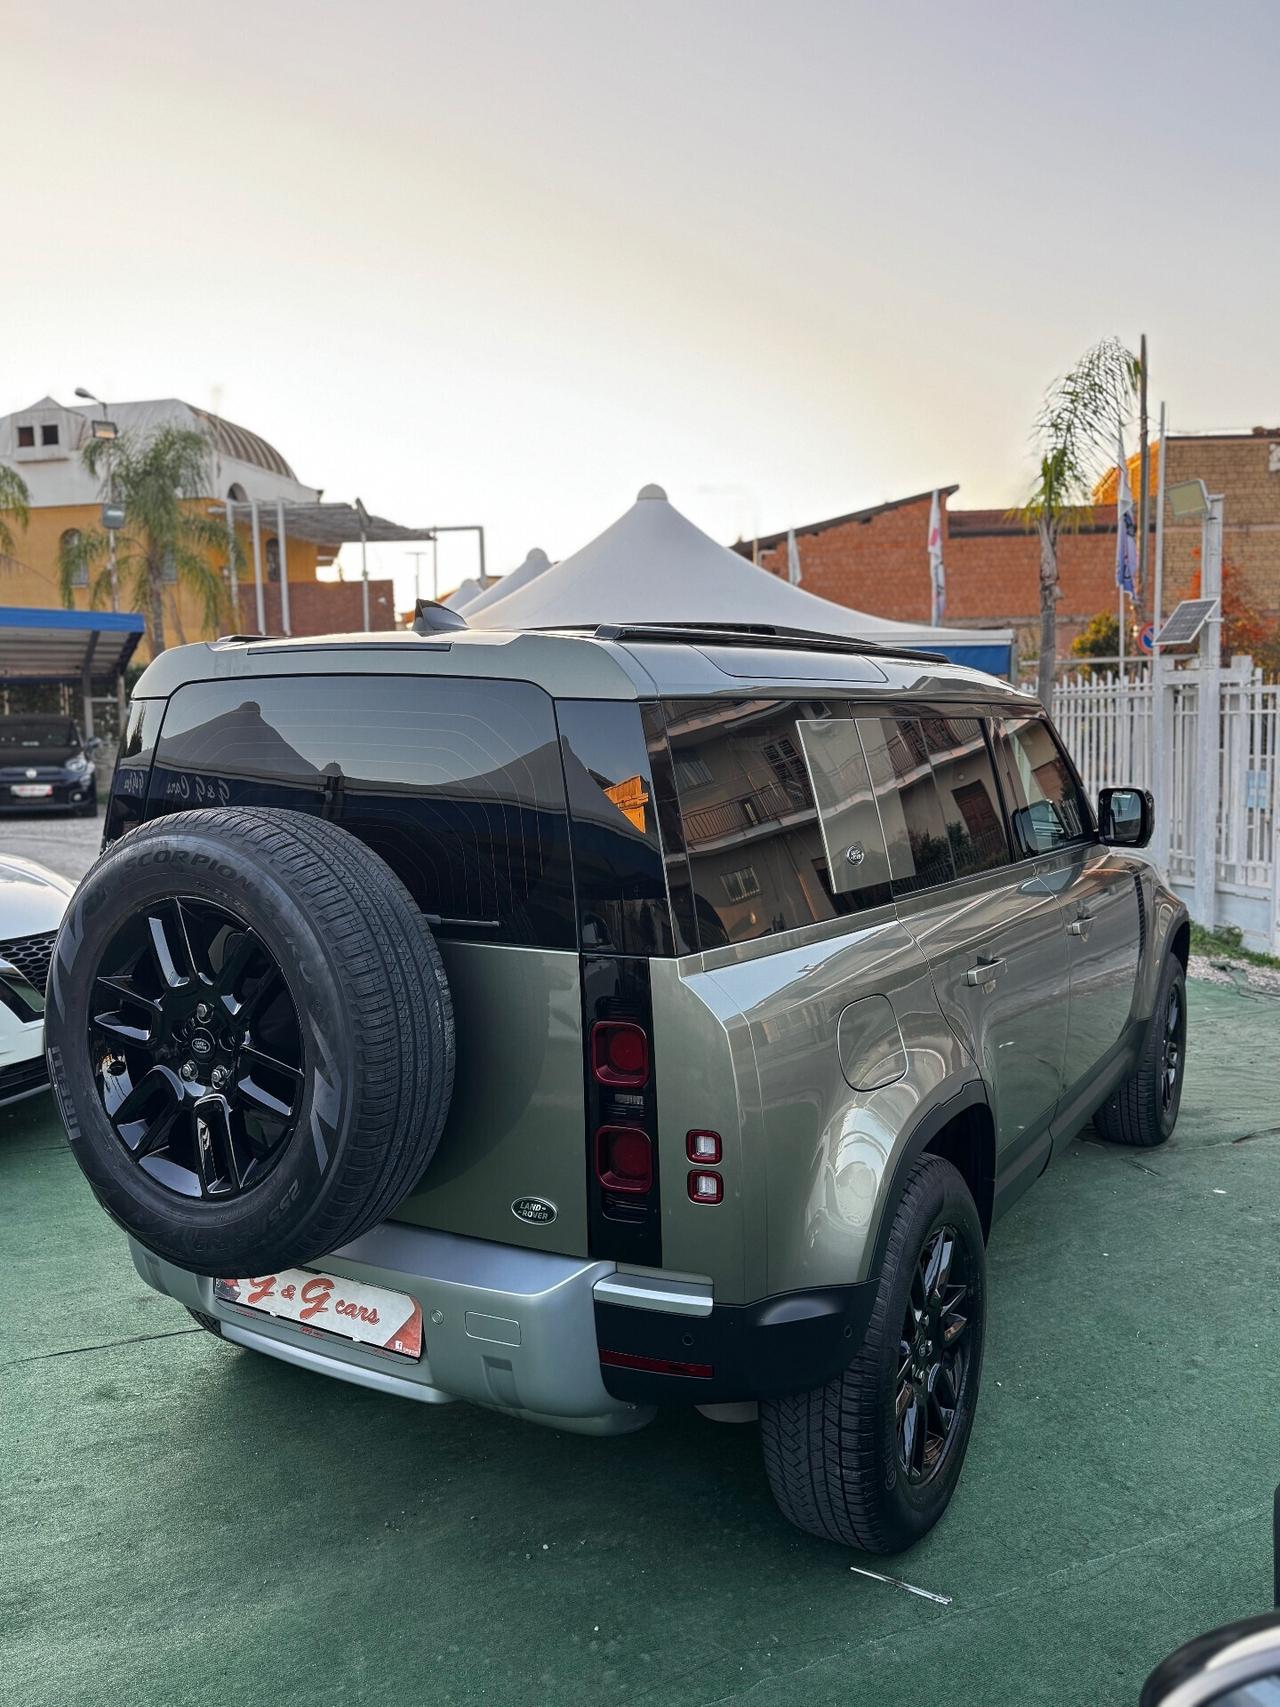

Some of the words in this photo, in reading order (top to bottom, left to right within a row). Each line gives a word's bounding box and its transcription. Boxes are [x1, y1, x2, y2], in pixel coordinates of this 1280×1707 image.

[123, 849, 260, 894] SCORPION
[280, 1284, 297, 1300] &
[299, 1277, 335, 1321] G
[335, 1299, 380, 1326] cars
